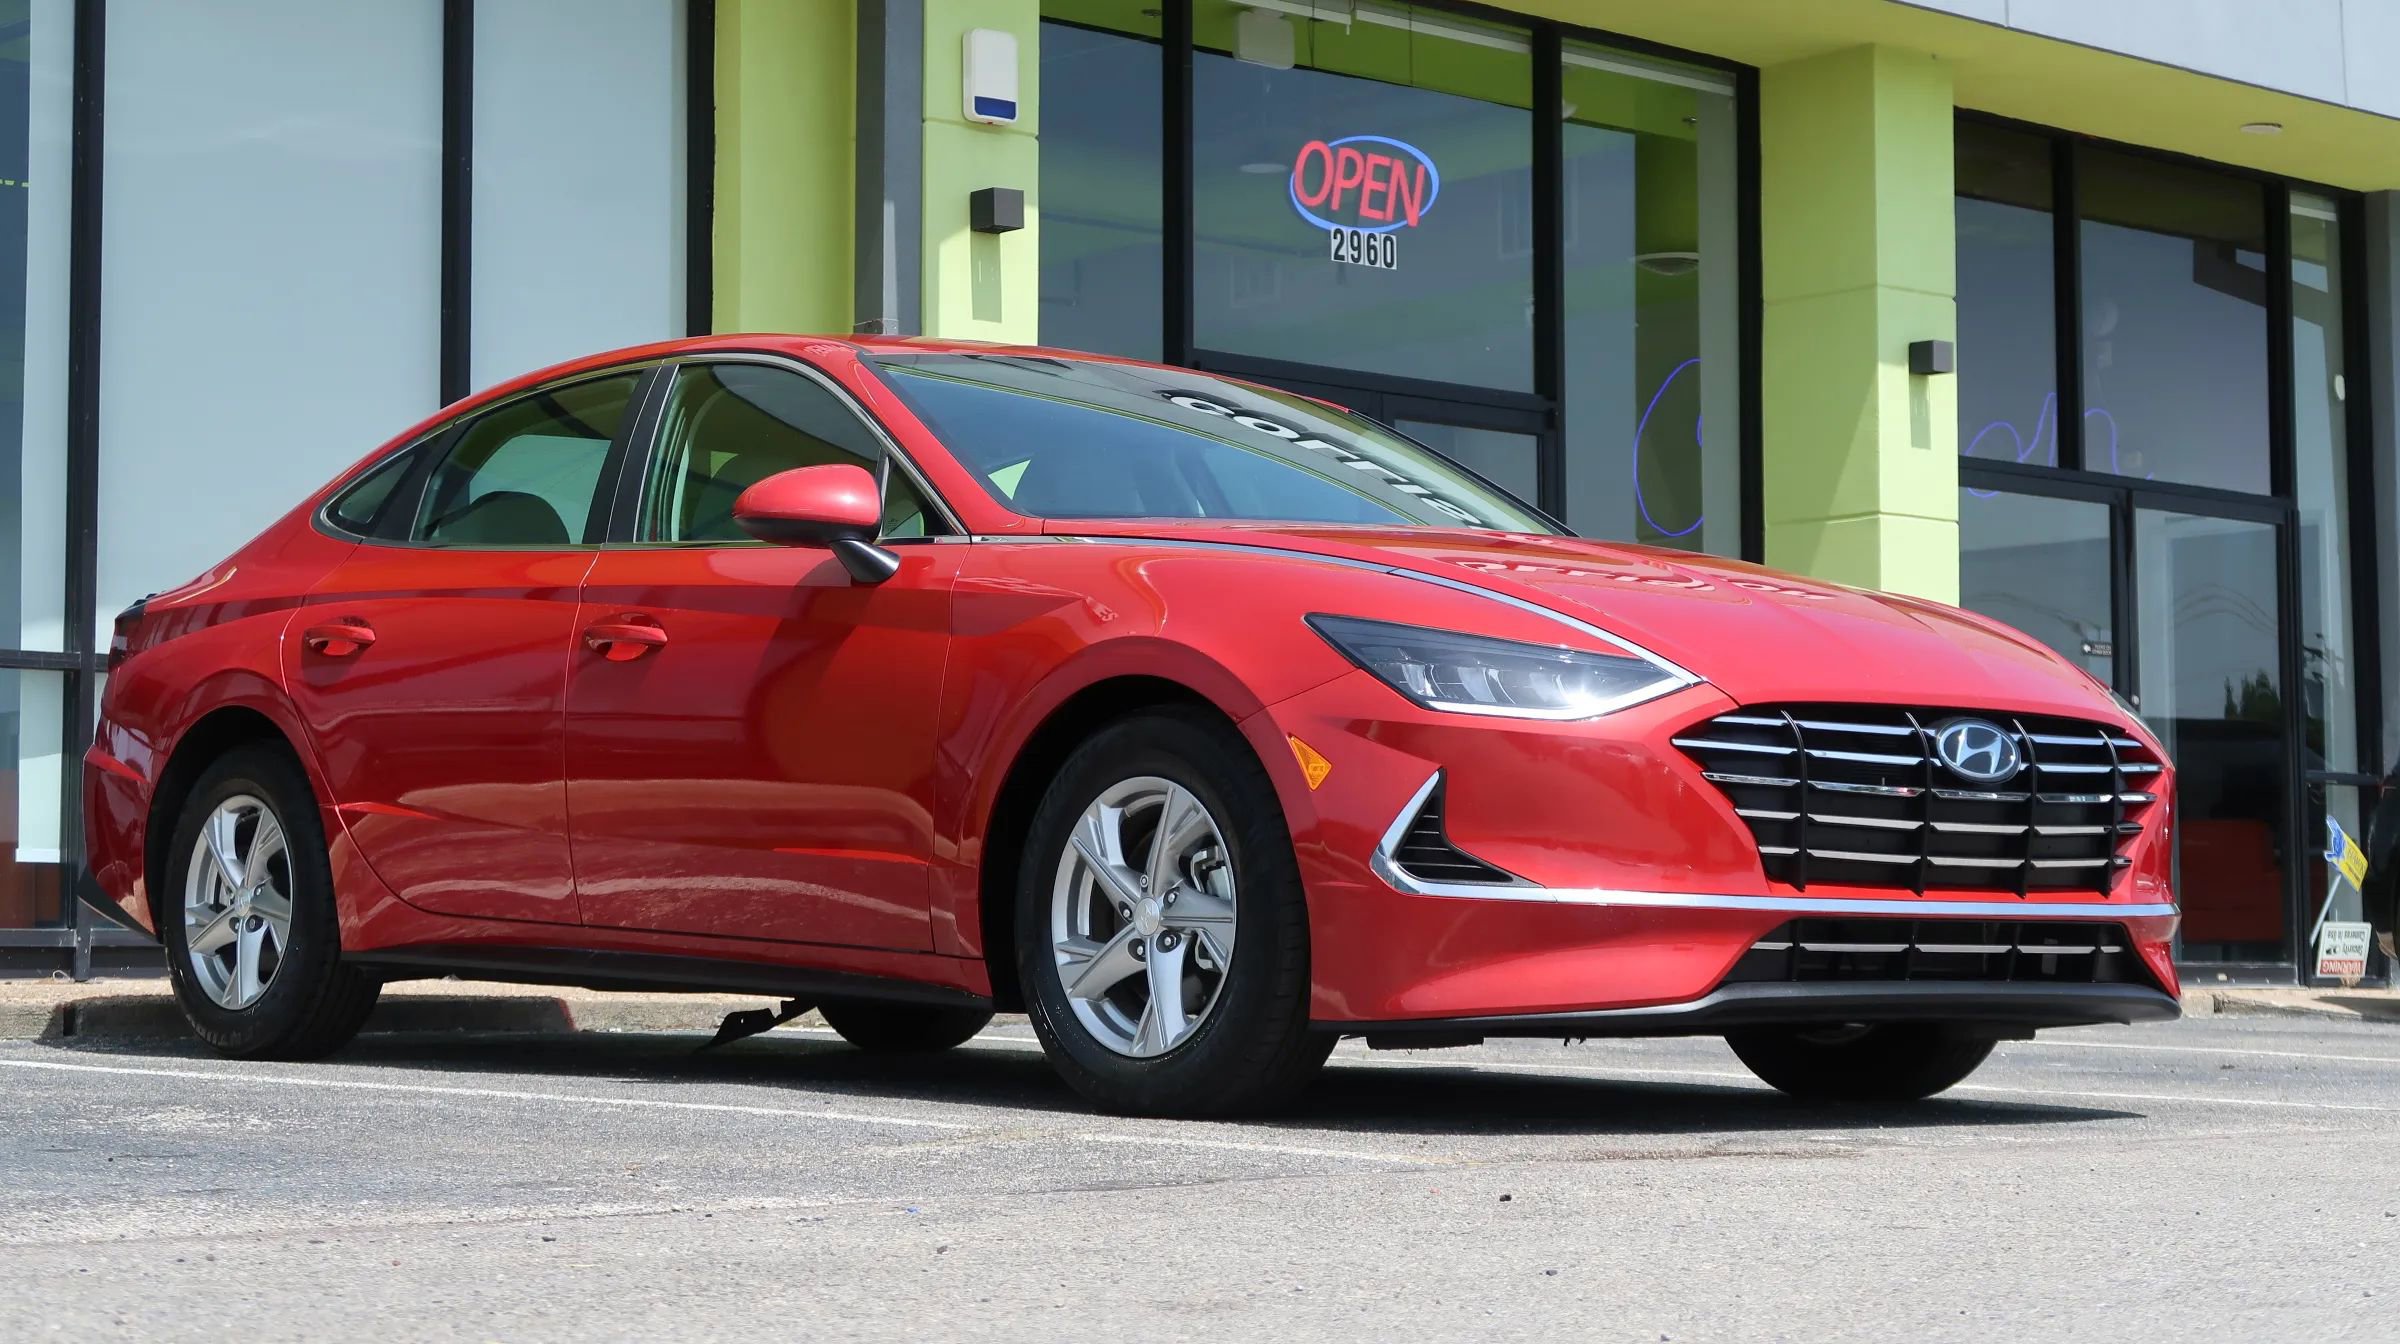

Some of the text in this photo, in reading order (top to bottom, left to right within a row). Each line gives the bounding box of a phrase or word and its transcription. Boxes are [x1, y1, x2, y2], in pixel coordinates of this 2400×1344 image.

[1295, 140, 1426, 228] OPEN
[1333, 228, 1395, 268] 2960
[2322, 961, 2362, 974] WARNING
